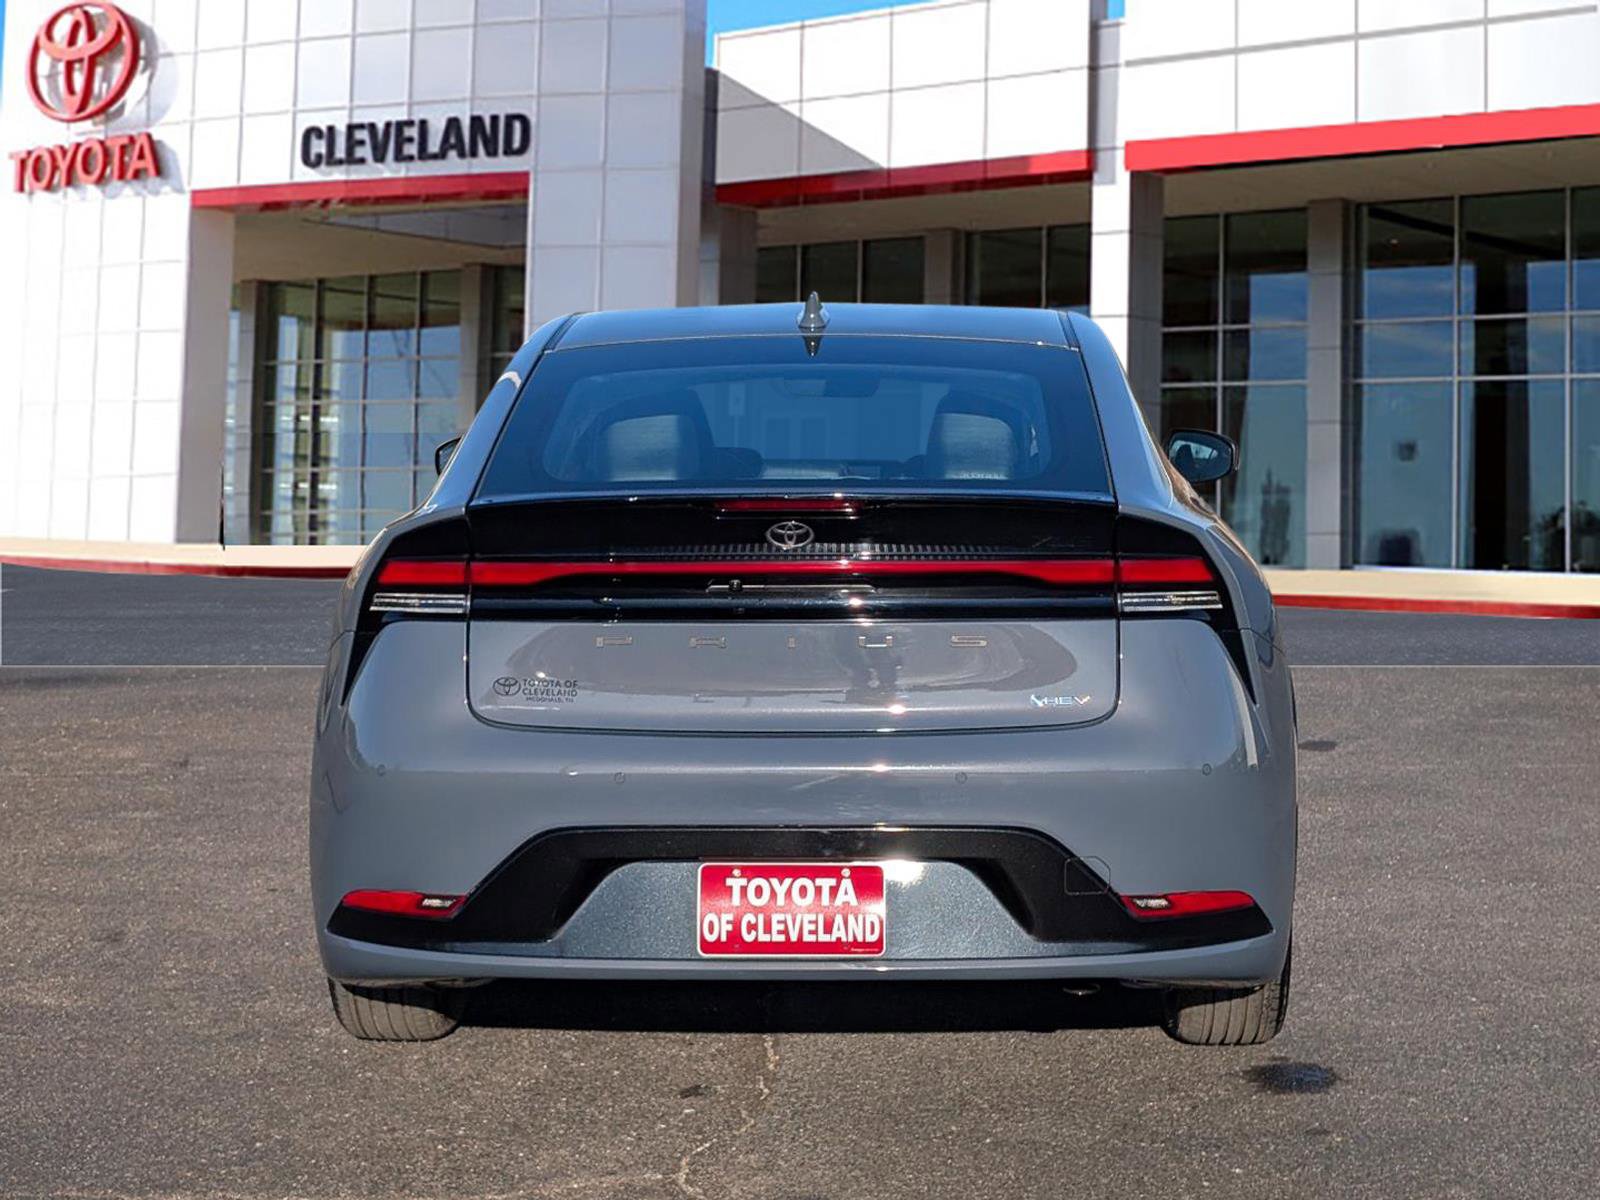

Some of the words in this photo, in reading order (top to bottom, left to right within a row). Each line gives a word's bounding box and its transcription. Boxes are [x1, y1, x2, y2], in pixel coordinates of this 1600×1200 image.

[301, 113, 531, 169] CLEVELAND
[9, 132, 160, 193] TOYOTA
[522, 679, 561, 688] TOYOTA
[564, 680, 578, 688] OF
[522, 688, 578, 697] CLEVELAND
[725, 877, 858, 907] TOYOTA
[703, 913, 733, 942] OF
[741, 912, 880, 943] CLEVELAND
